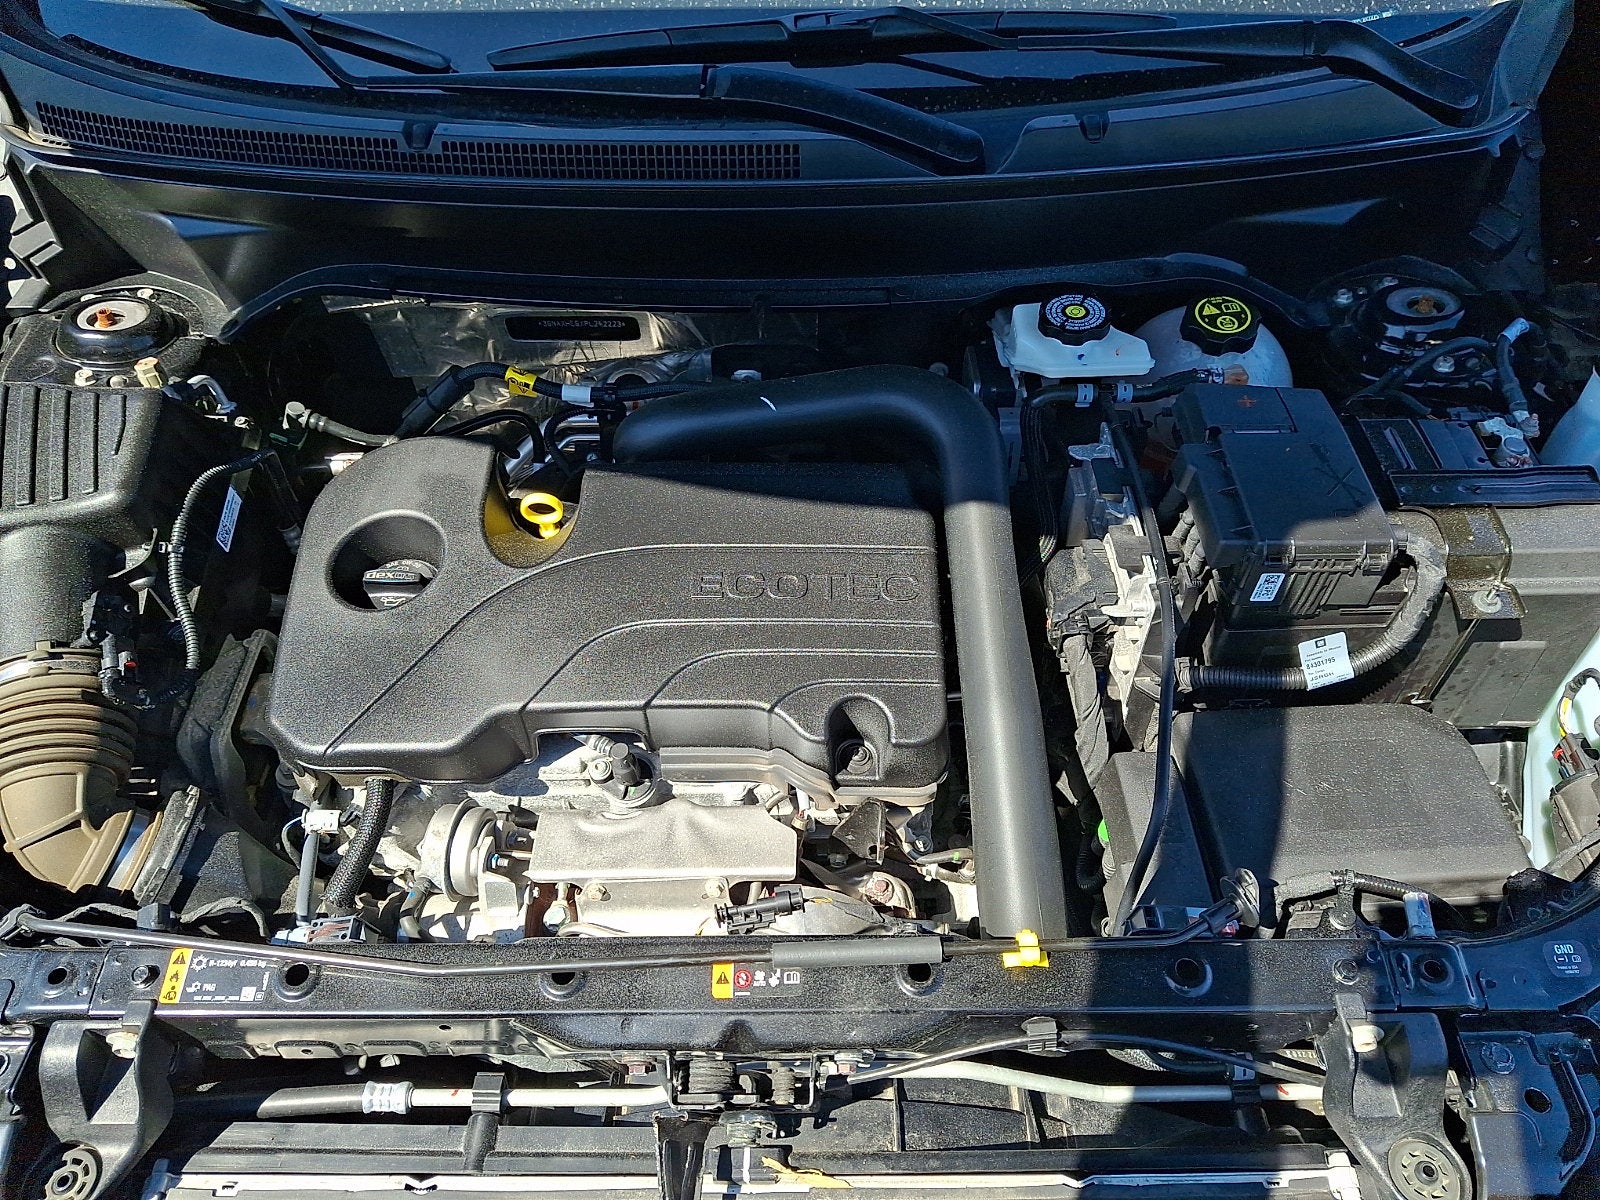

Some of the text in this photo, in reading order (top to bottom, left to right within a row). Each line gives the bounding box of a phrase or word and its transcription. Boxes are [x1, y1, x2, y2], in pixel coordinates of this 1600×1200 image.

[366, 572, 415, 580] dexos
[691, 571, 920, 602] ECOTEC
[1554, 944, 1574, 954] GND
[202, 983, 217, 991] PAG
